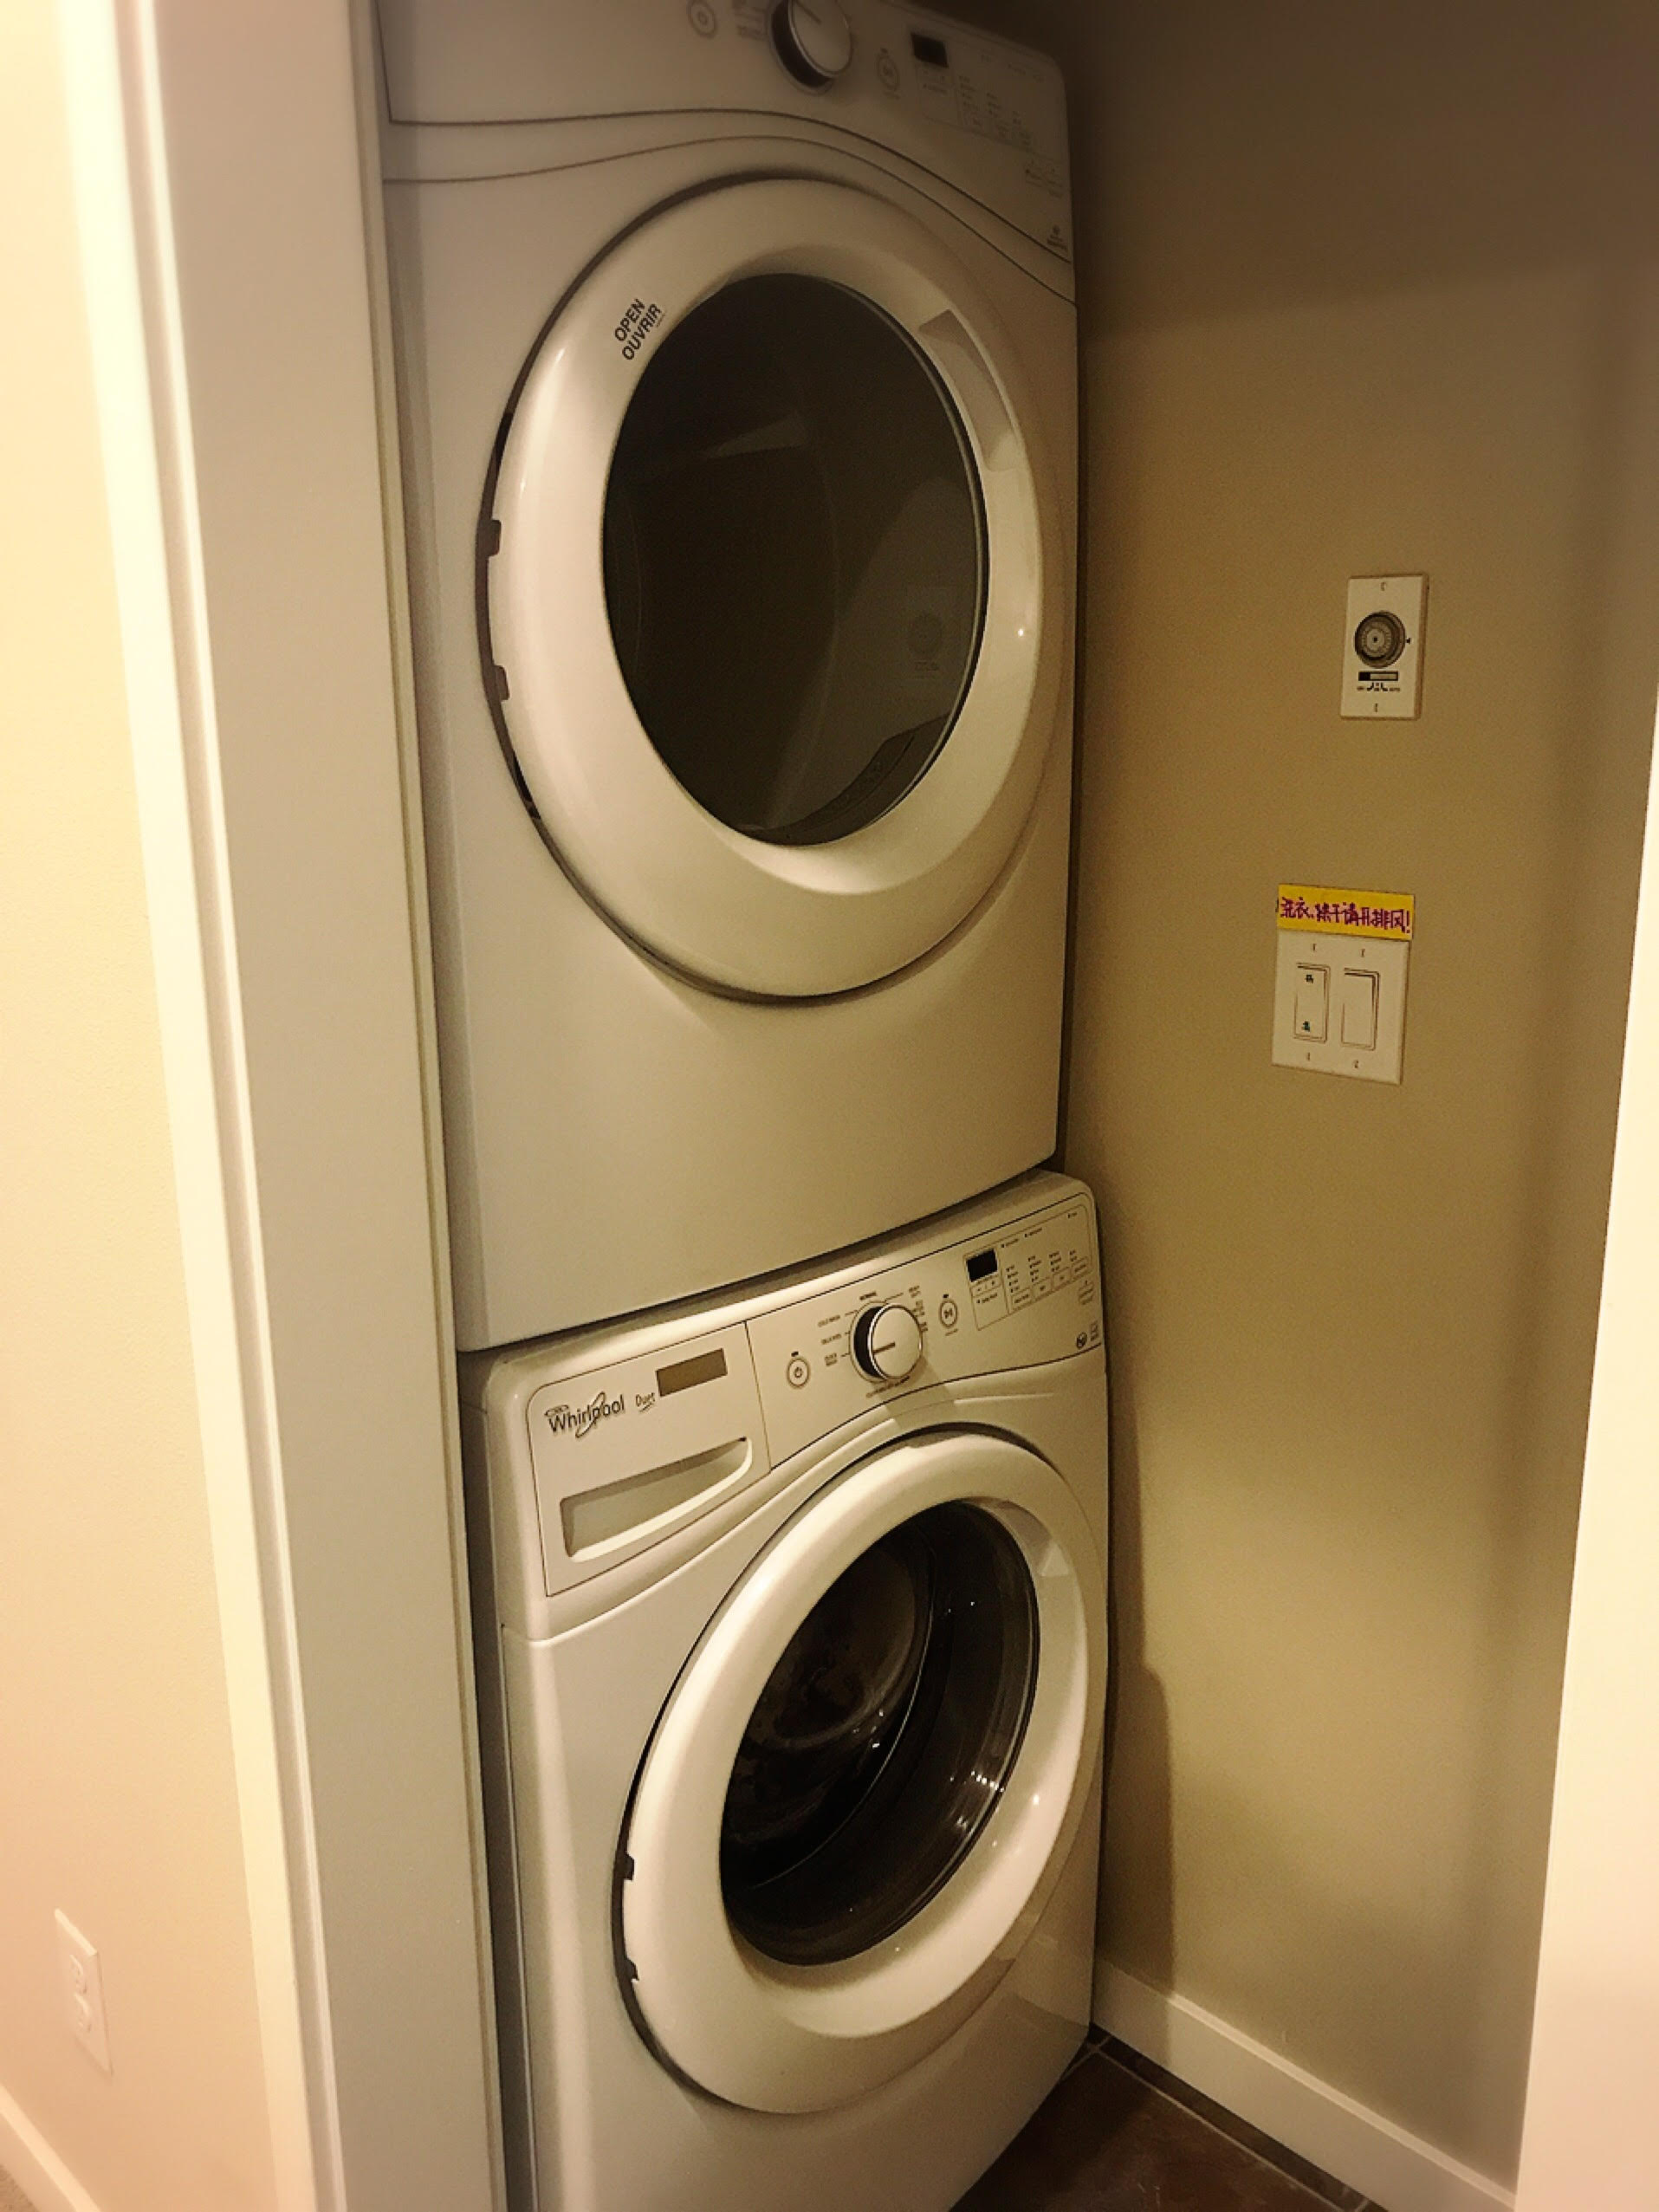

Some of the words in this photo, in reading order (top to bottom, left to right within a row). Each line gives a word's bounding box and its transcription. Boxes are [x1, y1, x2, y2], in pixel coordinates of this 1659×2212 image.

[614, 298, 645, 341] OPEN
[622, 303, 661, 360] OUVRIR
[547, 1392, 625, 1436] Whirlpool
